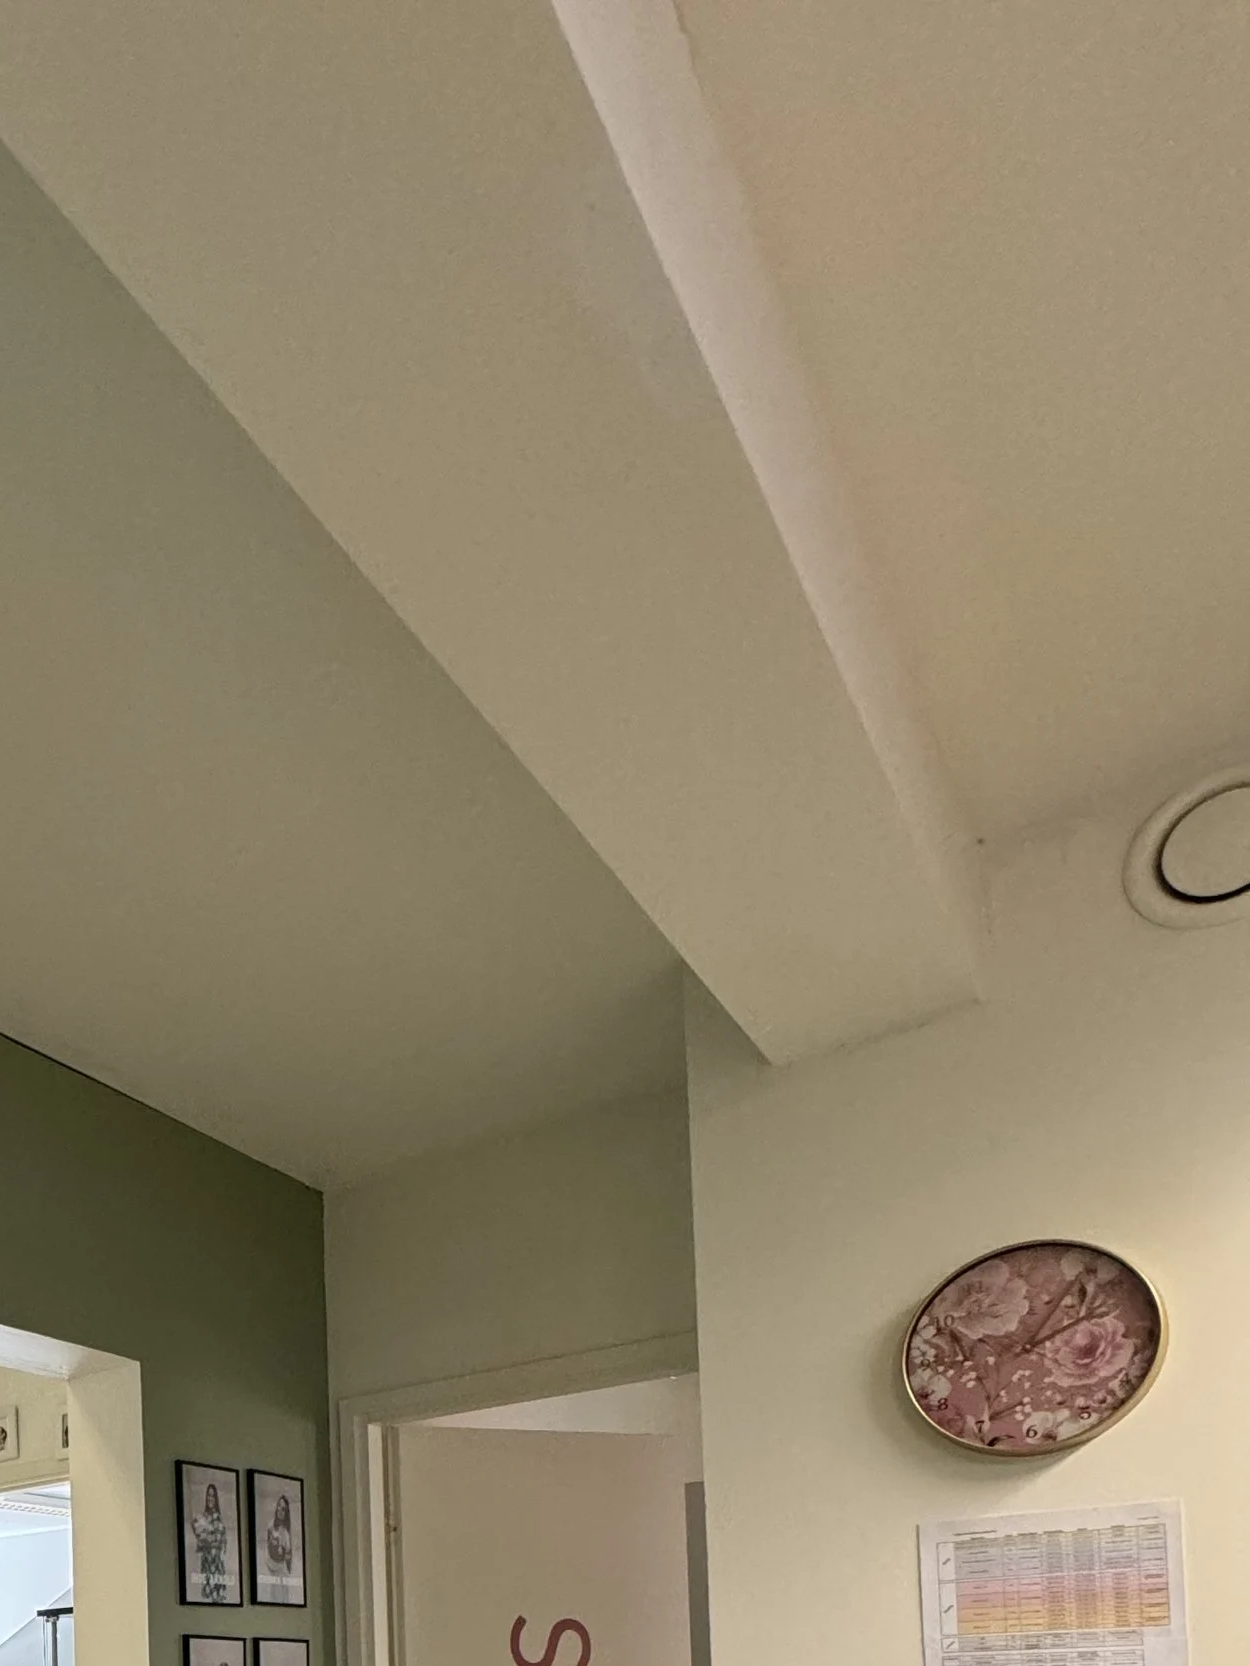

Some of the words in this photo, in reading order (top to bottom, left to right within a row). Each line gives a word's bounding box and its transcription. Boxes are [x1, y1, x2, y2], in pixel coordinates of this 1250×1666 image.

[933, 1314, 955, 1331] 10
[937, 1397, 949, 1411] 8
[975, 1420, 985, 1433] 7
[1025, 1424, 1039, 1439] 6
